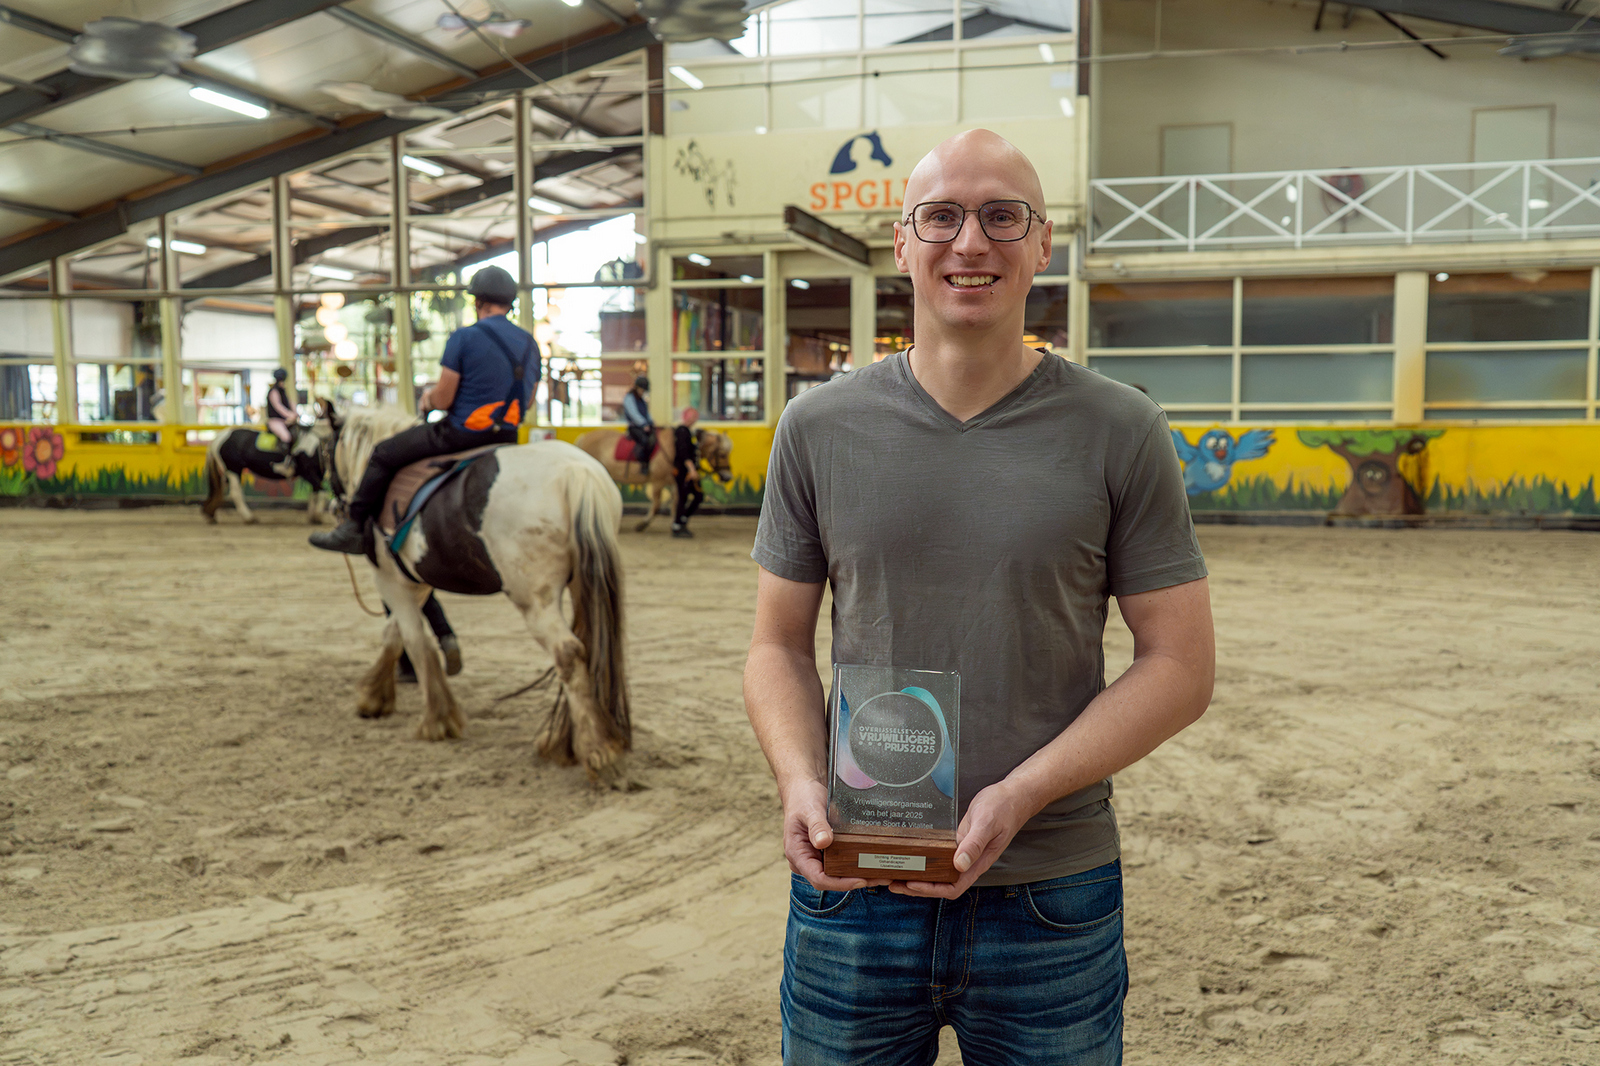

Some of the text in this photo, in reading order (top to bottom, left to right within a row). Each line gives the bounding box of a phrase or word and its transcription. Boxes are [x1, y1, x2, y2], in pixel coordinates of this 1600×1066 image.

[859, 731, 936, 745] VRIJWILLIGERS
[890, 810, 904, 818] jaar
[905, 811, 924, 819] 2025
[850, 818, 881, 827] Categorie
[882, 820, 901, 828] Sport
